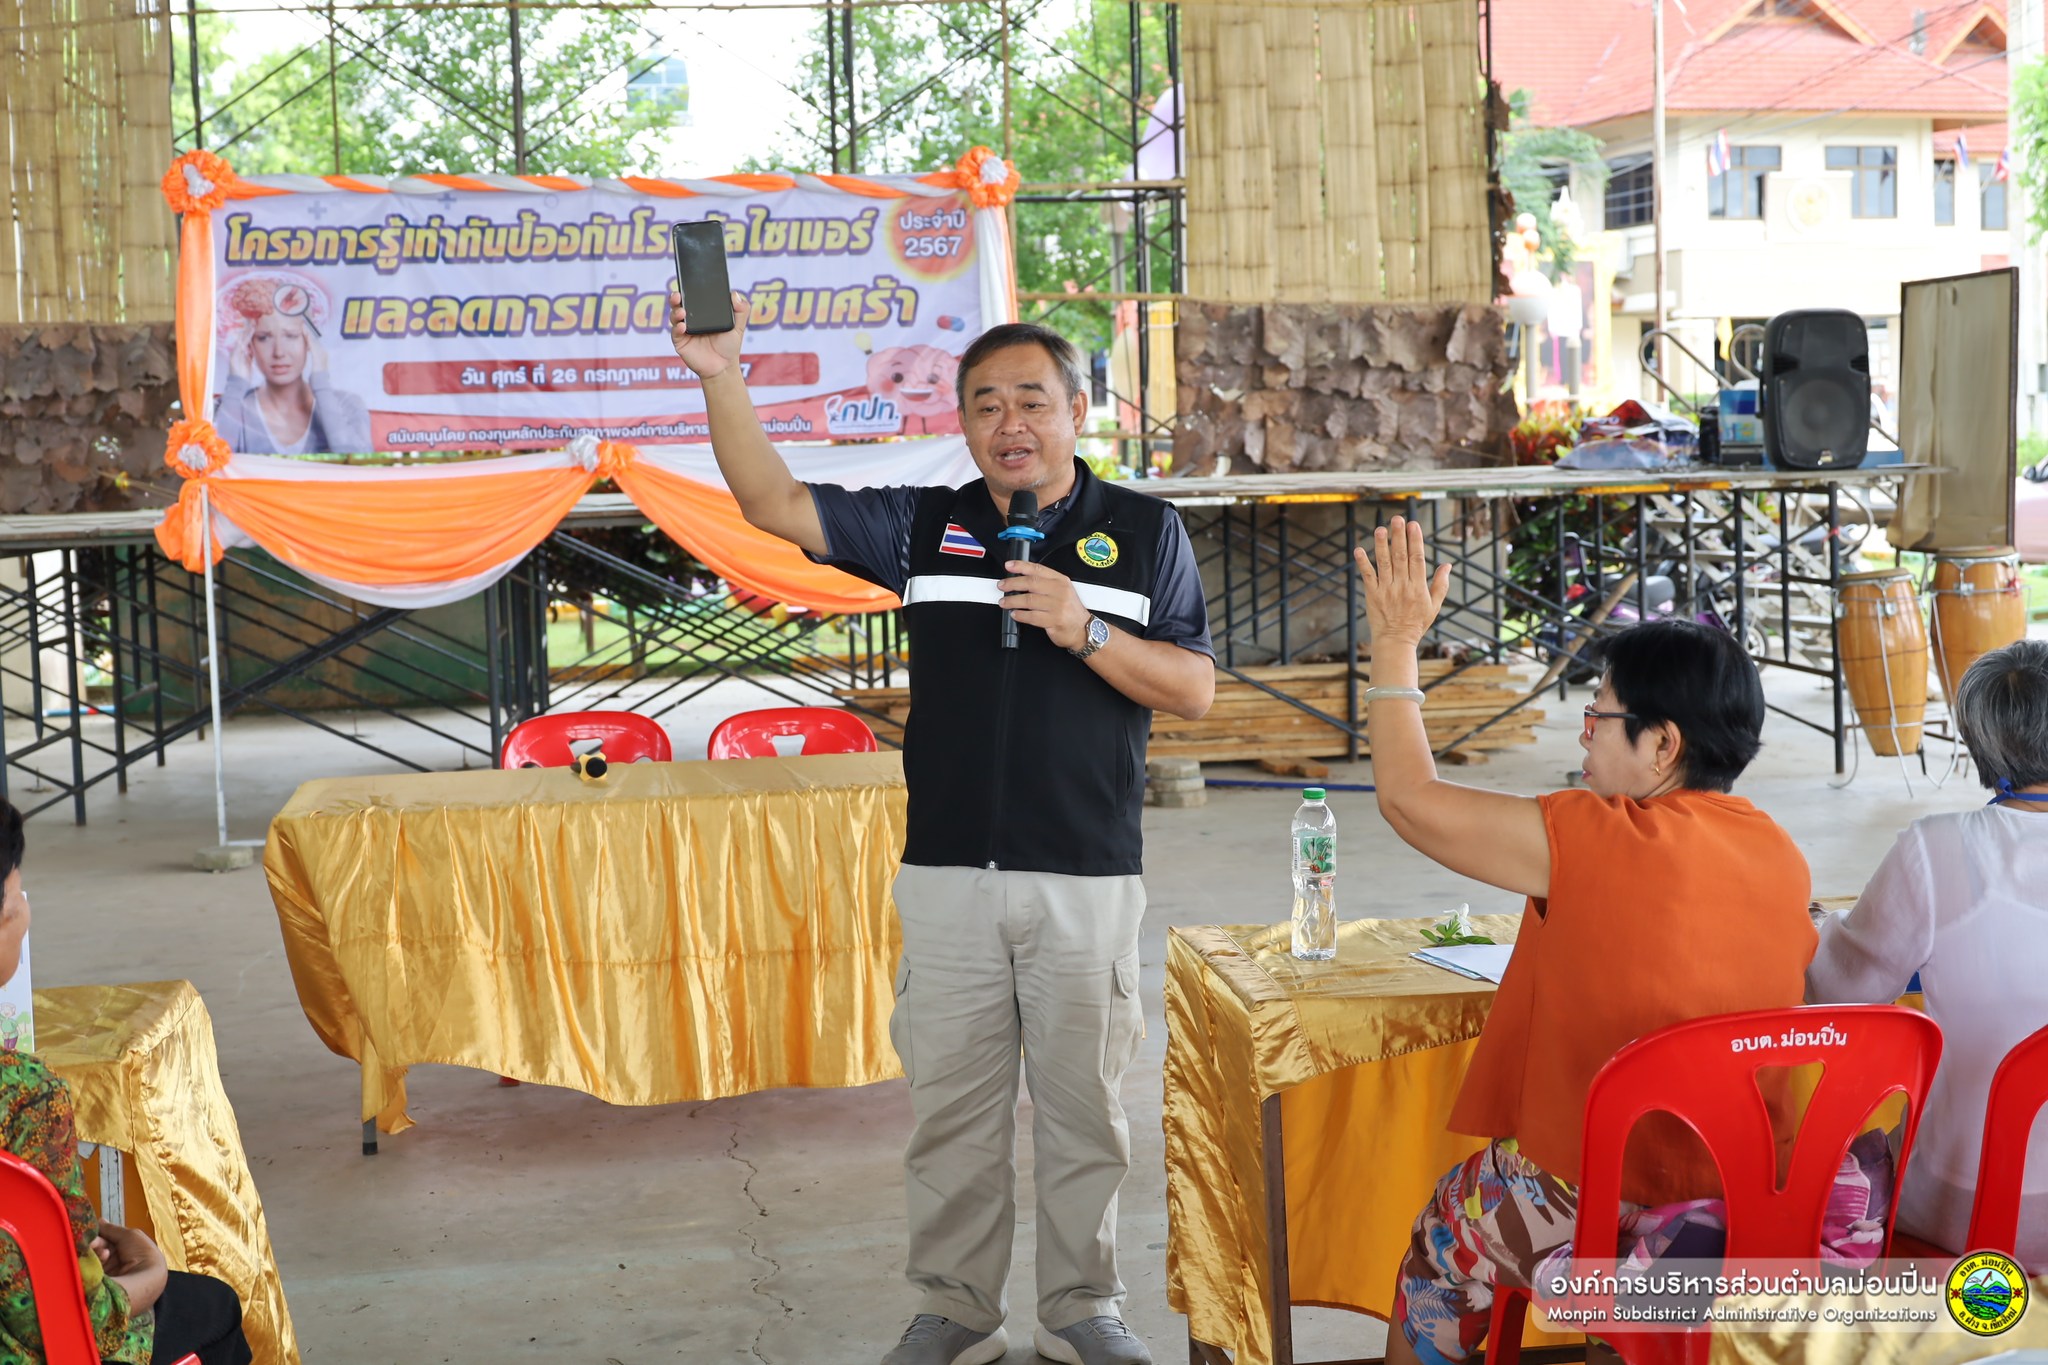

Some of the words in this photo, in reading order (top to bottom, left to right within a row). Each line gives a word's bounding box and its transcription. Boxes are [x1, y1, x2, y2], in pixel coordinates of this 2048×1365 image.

[899, 208, 966, 231] ประจำปี
[904, 236, 963, 258] 2567
[340, 275, 919, 341] และลดการเกิดซึมเศร้า
[461, 366, 485, 387] วัน
[491, 365, 527, 389] ศุกร์
[532, 363, 546, 385] ที่
[552, 367, 577, 384] 26
[583, 366, 660, 387] กรกฎาคม
[388, 427, 466, 447] สนับสนุนโดย
